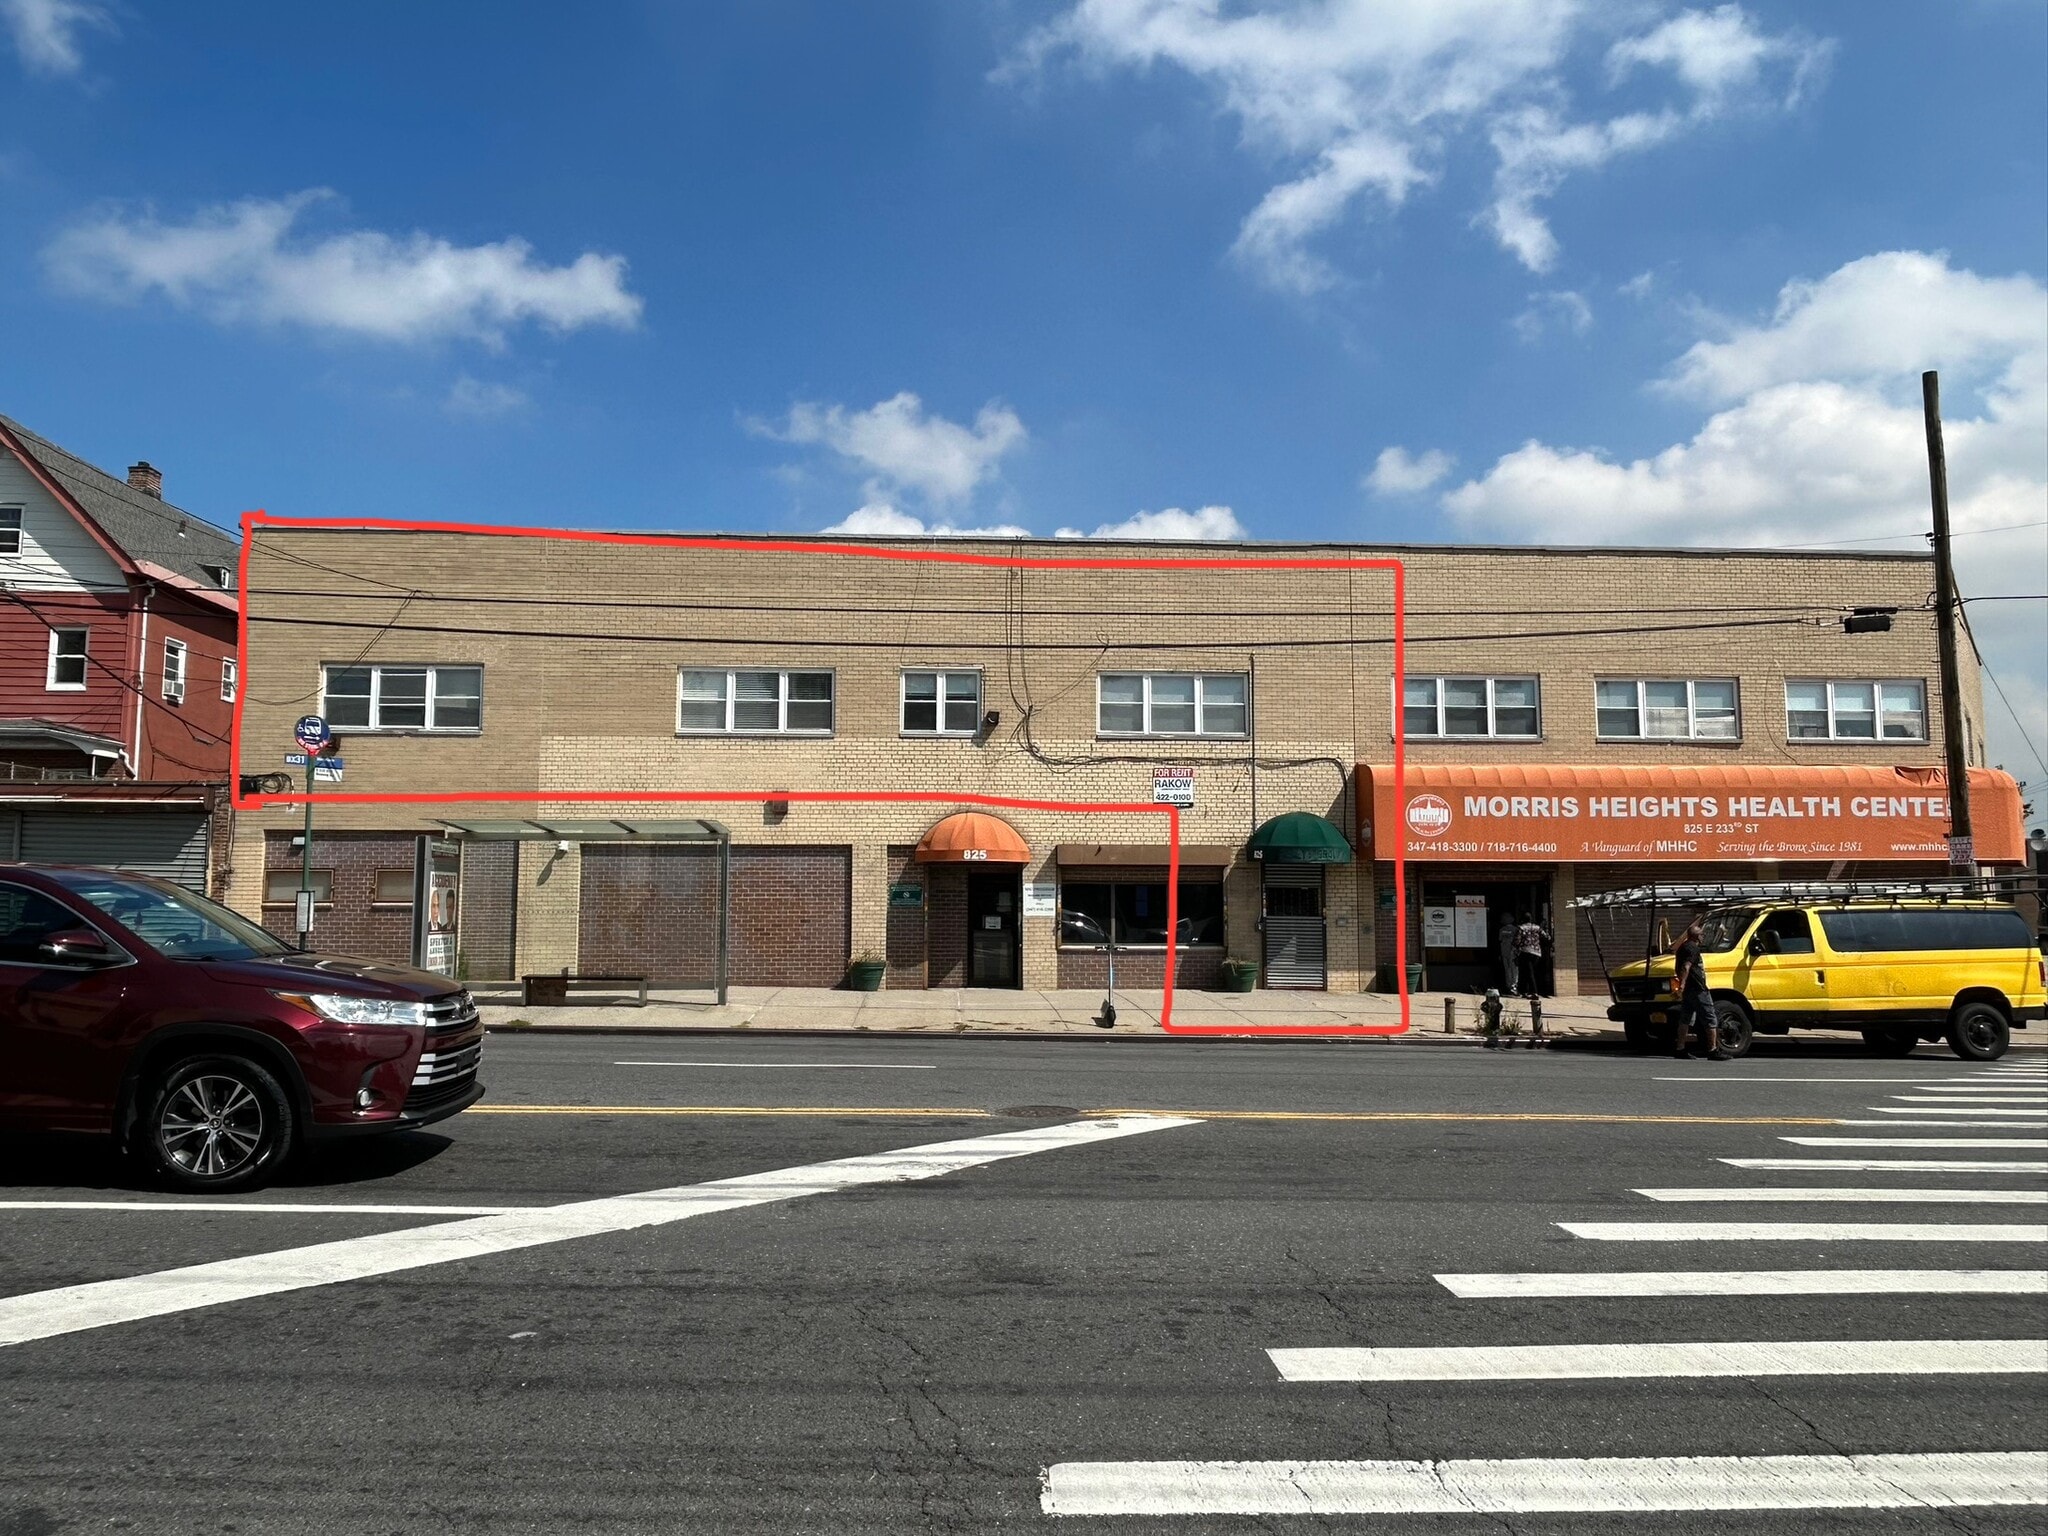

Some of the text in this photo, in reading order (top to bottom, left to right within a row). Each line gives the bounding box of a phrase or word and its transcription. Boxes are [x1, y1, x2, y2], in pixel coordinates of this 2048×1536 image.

[1154, 768, 1192, 777] FOR RENT
[1154, 779, 1192, 788] RAKOW
[1156, 793, 1192, 801] 422-0100
[1463, 796, 1580, 818] MORRIS
[1589, 796, 1719, 818] HEIGHTS
[1728, 796, 1841, 818] HEALTH
[1850, 796, 1951, 818] CENTE
[1683, 823, 1703, 834] 825
[1705, 824, 1713, 833] E
[1745, 823, 1760, 833] ST
[1407, 842, 1557, 853] 347-418-3300 / 718-716-4400
[1580, 840, 1698, 857] A Vanguard of MHHC
[1717, 841, 1863, 856] Serving the Bronx Since 1981
[1891, 842, 1949, 852] www.mhhc
[963, 849, 988, 860] 825
